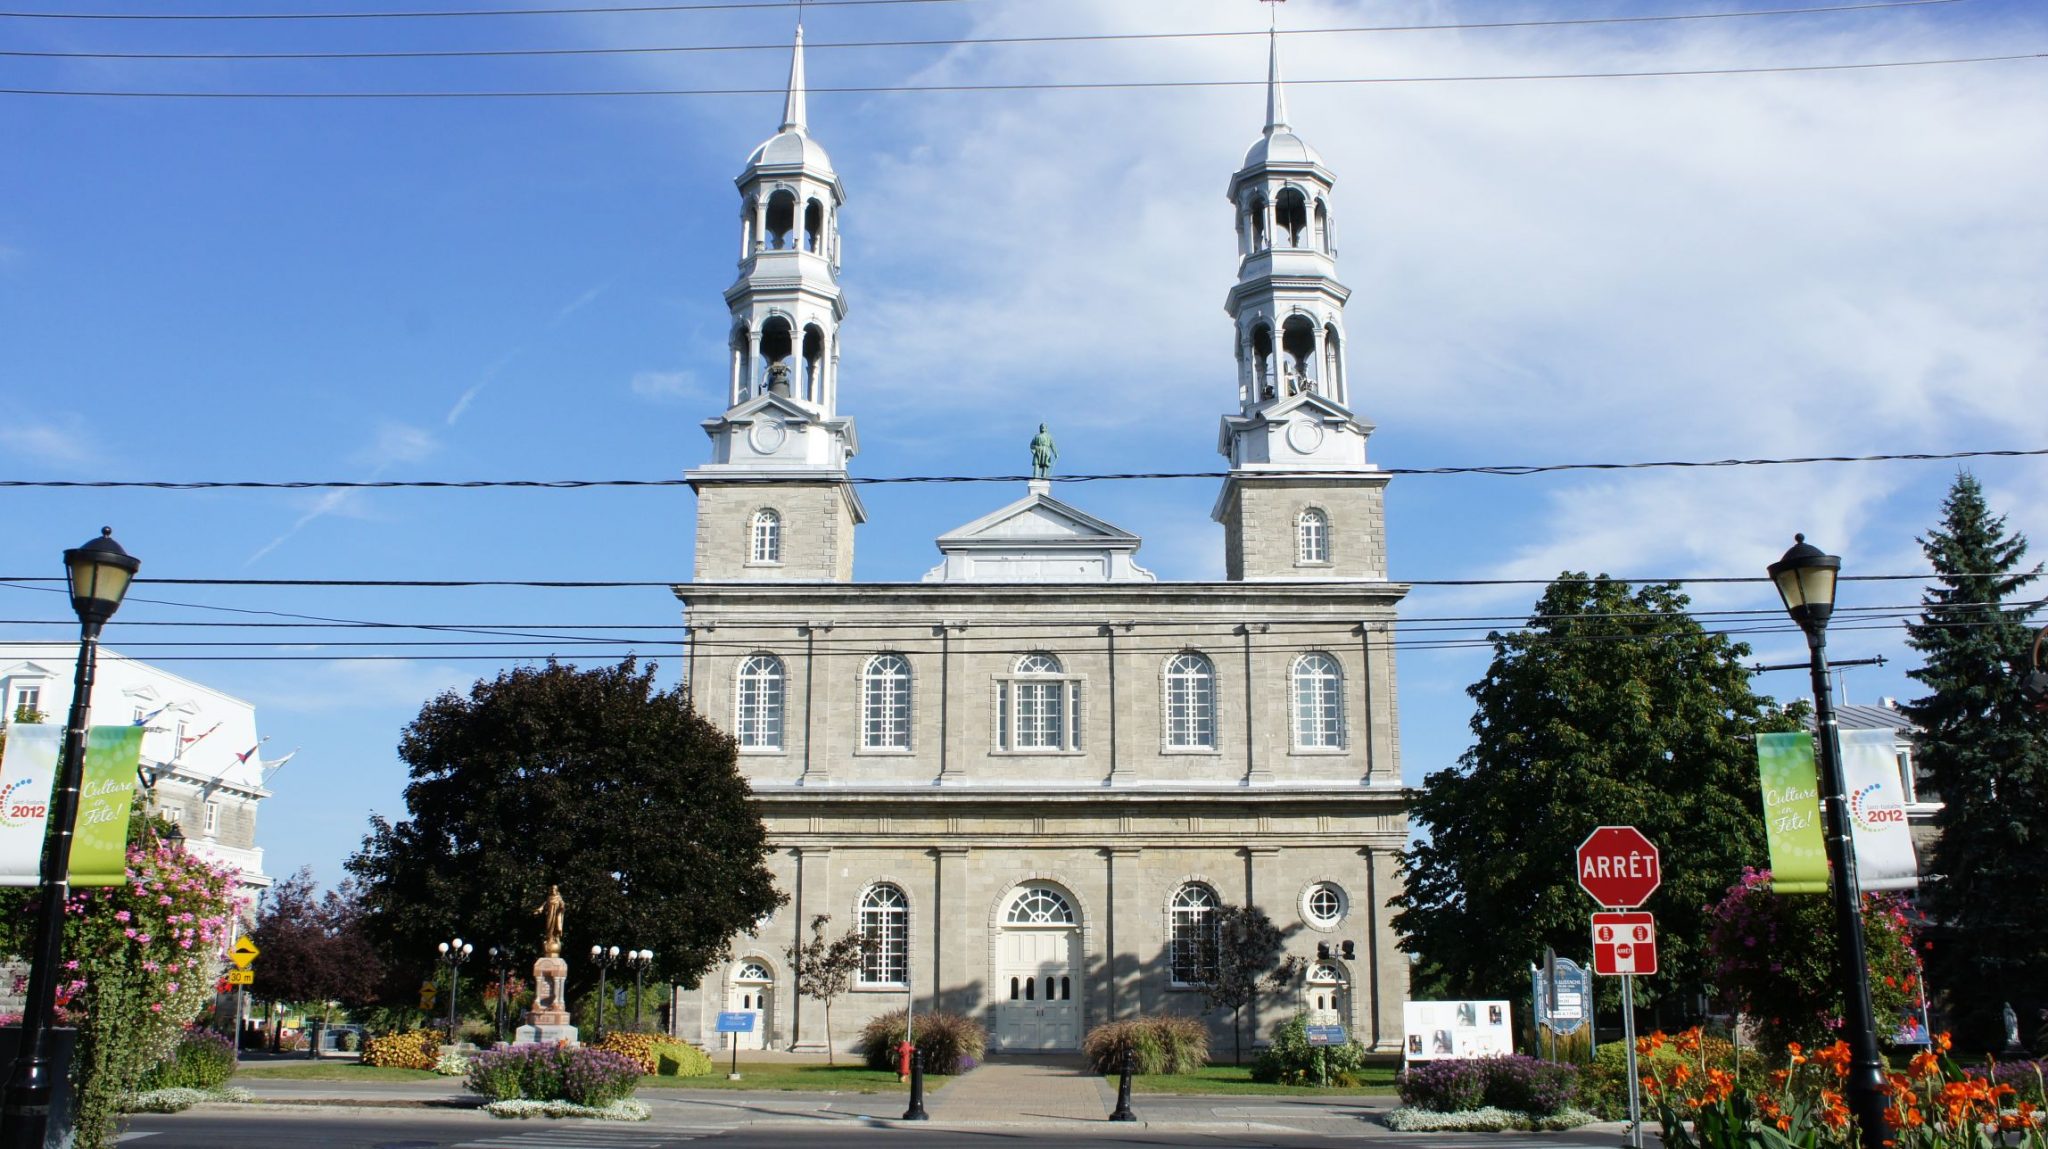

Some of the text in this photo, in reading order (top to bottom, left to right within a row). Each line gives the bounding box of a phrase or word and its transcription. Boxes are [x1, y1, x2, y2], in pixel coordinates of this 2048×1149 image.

[83, 779, 133, 798] Culture
[1766, 785, 1816, 807] Culture
[11, 805, 46, 818] 2012
[1867, 810, 1903, 822] 2012
[1583, 850, 1654, 878] ARRÊT
[231, 973, 241, 981] 30
